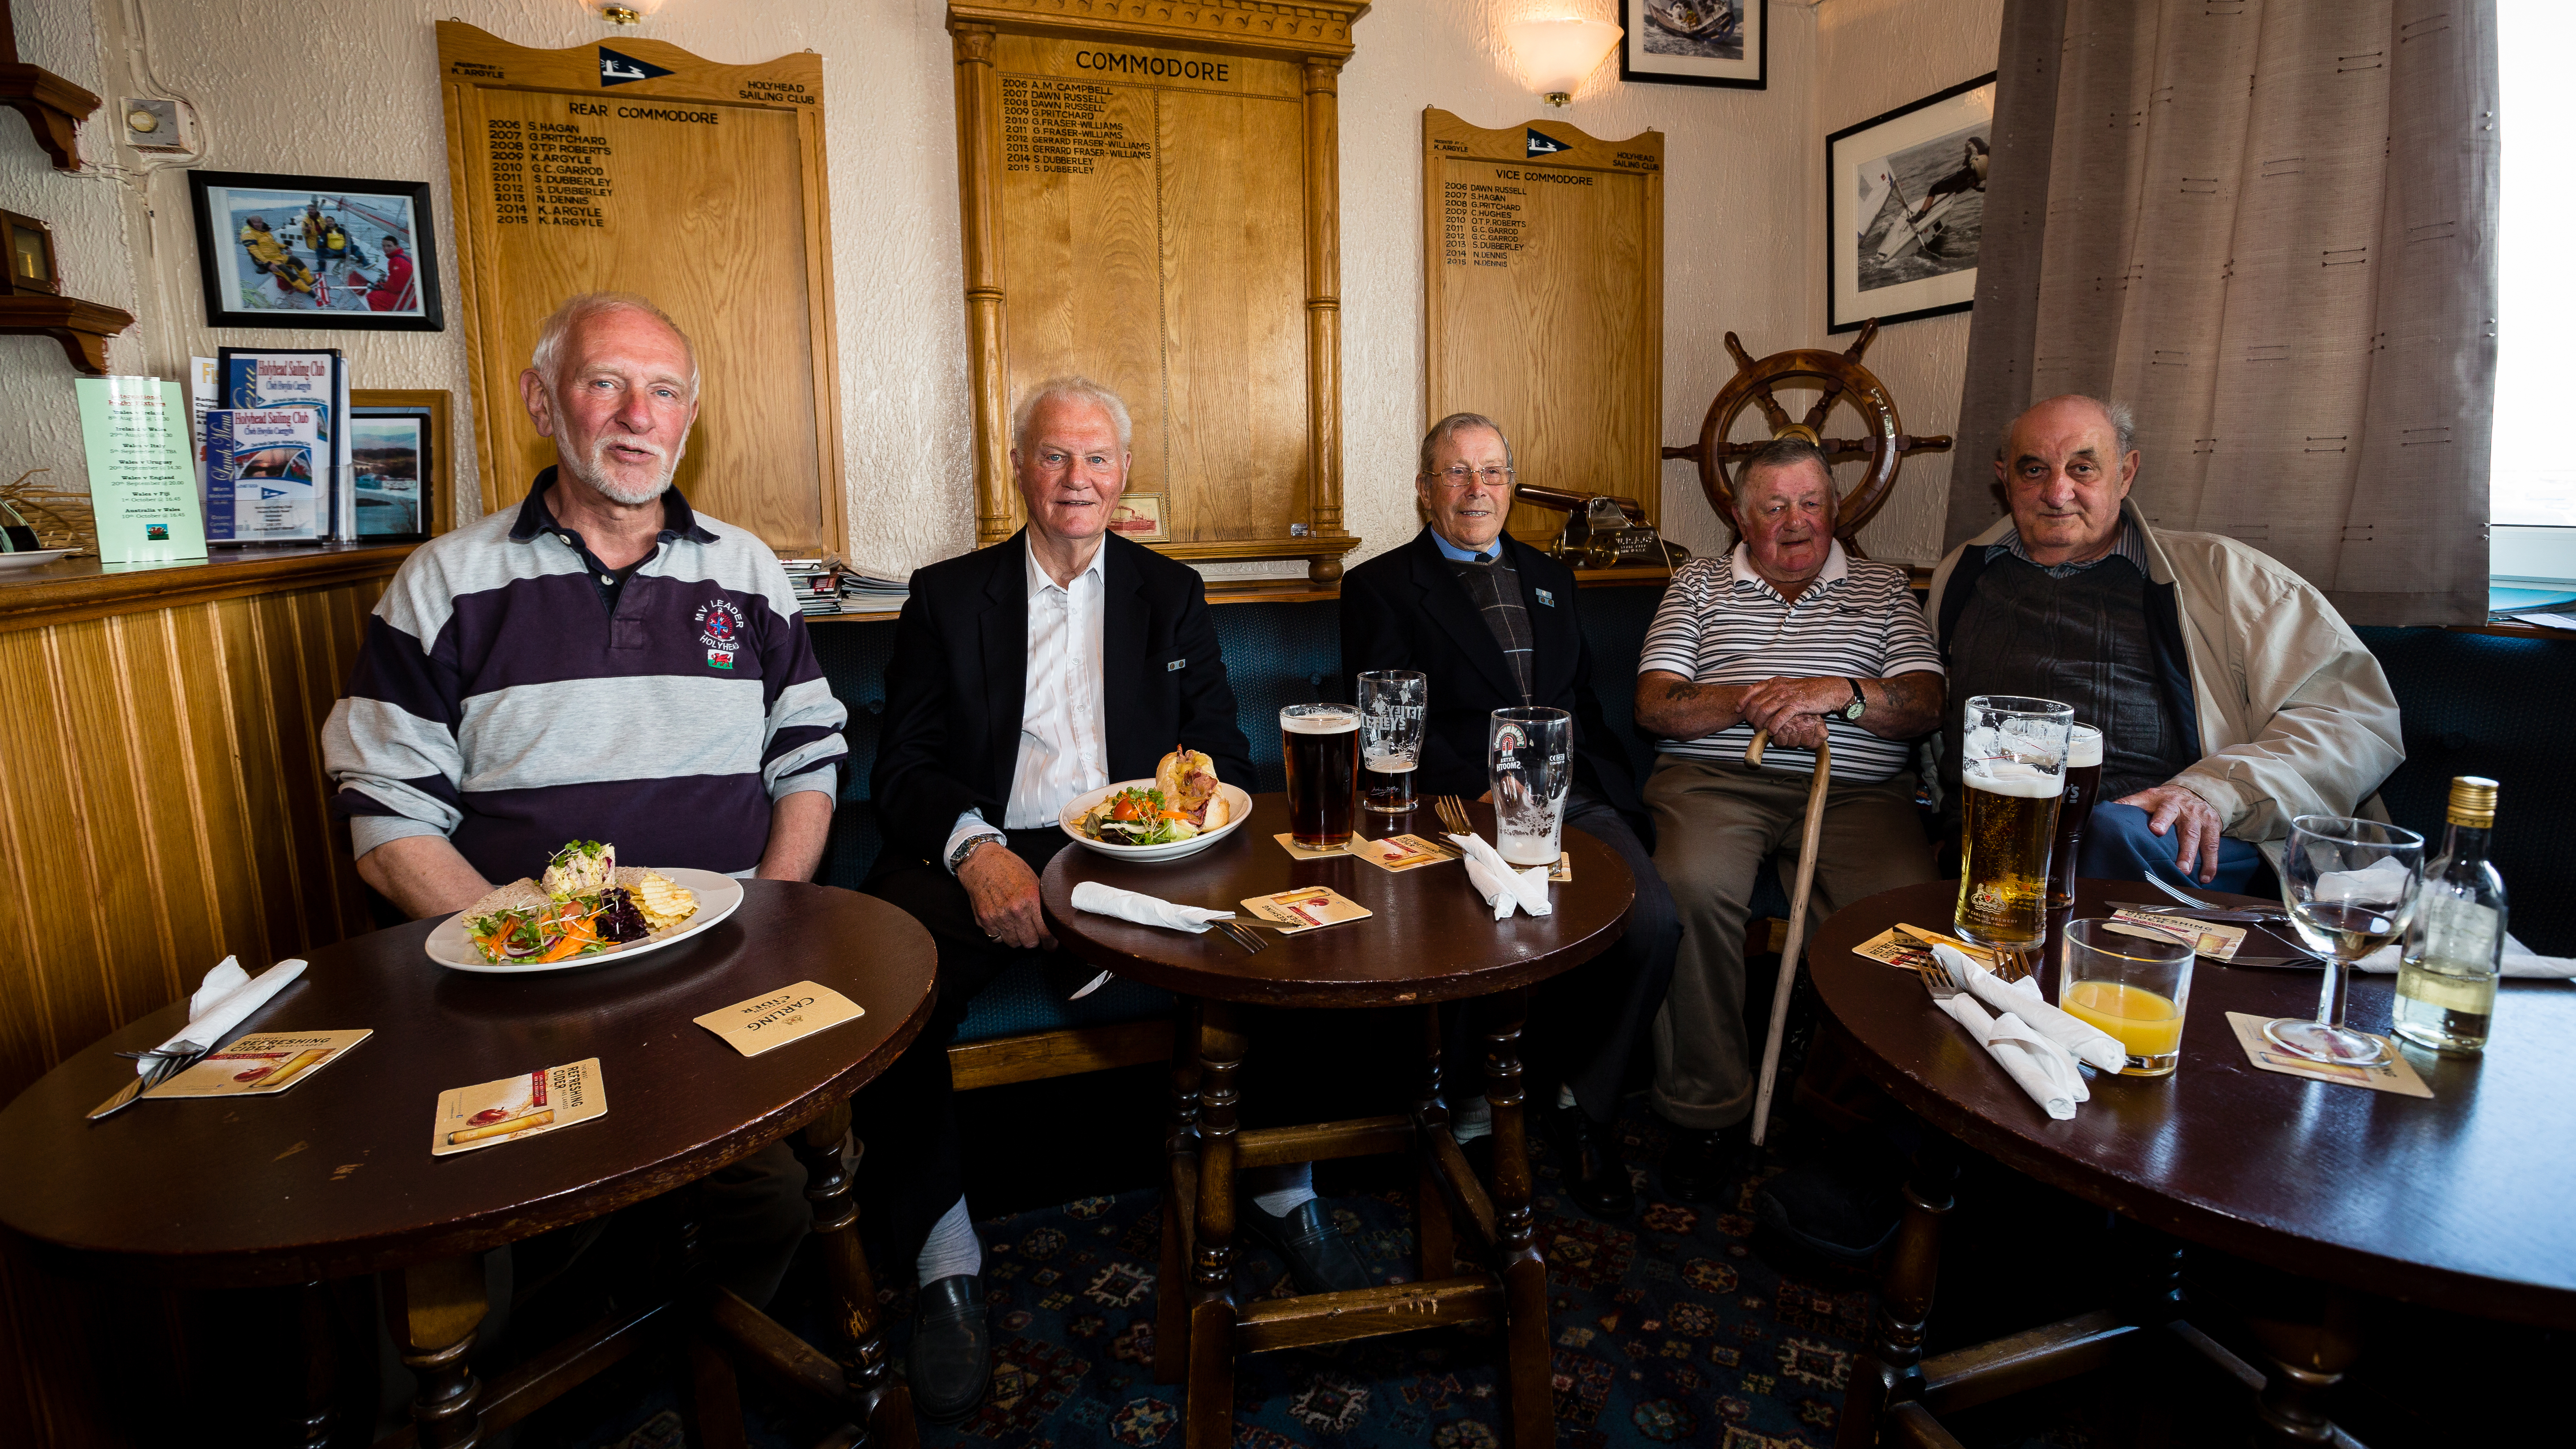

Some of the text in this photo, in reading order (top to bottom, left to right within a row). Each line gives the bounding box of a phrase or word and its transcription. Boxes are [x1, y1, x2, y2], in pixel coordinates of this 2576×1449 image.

[1076, 51, 1229, 82] COMMODORE
[748, 80, 805, 93] HOLYHEAD
[1002, 79, 1027, 88] 2006
[739, 90, 815, 105] SAILING CLUB
[1004, 89, 1106, 104] 2007 DAWN RUSSELL
[1004, 98, 1105, 112] 2008 DAWN RUSSELL
[1004, 107, 1029, 115] 2009
[569, 102, 718, 125] REAR COMMODORE
[488, 119, 521, 129] 2006
[1005, 116, 1029, 125] 2010
[489, 130, 521, 140] 2007
[1005, 125, 1027, 133] 2011
[490, 141, 523, 150] 2008
[1006, 134, 1151, 150] 2012 GERRARD FRASER-WILLIAMS
[492, 152, 523, 160] 2009
[1007, 144, 1151, 159] 2013 GERRARD FRASER-WILLIAMS
[1007, 153, 1030, 162] 2014
[1617, 152, 1654, 162] HOLYHEAD
[492, 163, 522, 171] 2010
[1613, 160, 1659, 170] SAILING CLUB
[492, 173, 521, 182] 2011
[1496, 169, 1593, 186] VICE COMMODORE
[494, 183, 523, 192] 2012
[1445, 182, 1527, 195] 2006 DAWN RUSSELL
[494, 193, 525, 201] 2013
[496, 203, 526, 213] 2014
[497, 216, 528, 224] 2015
[258, 360, 325, 380] Holyhead Sailing Club
[235, 412, 309, 427] Holyhead Sailing Club
[209, 414, 233, 446] Menu
[210, 449, 235, 482] Lunch
[711, 600, 743, 628] LEADER
[699, 635, 739, 650] HOLYHEAD
[1396, 839, 1415, 847] CIDER
[1402, 837, 1439, 853] REFRESHING
[2125, 913, 2165, 924] CIDER
[1869, 938, 1900, 955] REFRESH
[1880, 947, 1902, 958] CIDER
[741, 996, 790, 1013] CIDER
[747, 997, 814, 1031] CARLING
[237, 1038, 331, 1046] REFRESHING
[554, 1070, 566, 1090] CIDER
[567, 1066, 584, 1107] REFRESHING
